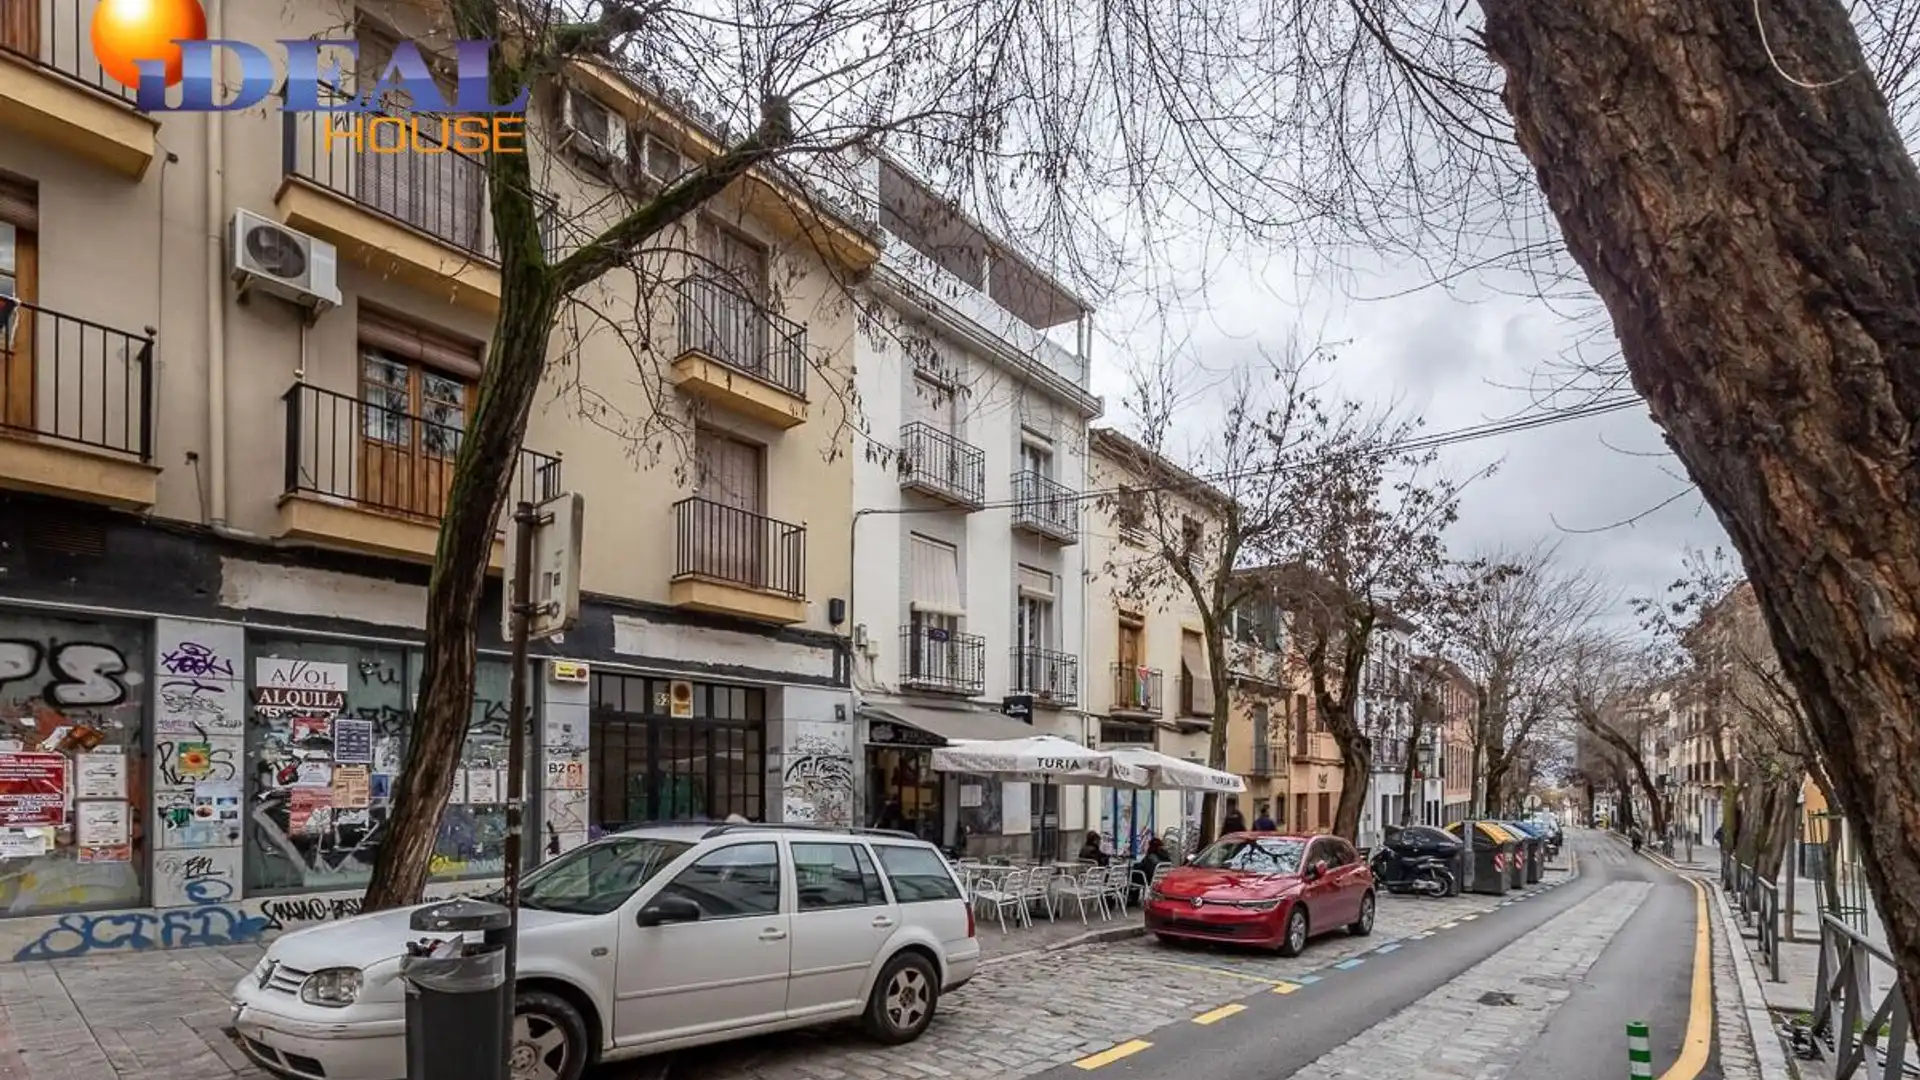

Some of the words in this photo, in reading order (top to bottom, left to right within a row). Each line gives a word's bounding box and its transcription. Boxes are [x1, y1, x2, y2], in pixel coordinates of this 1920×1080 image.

[271, 660, 337, 685] AVOL
[259, 690, 345, 708] ALQUILA
[548, 762, 565, 774] B2
[1037, 757, 1080, 770] TURIA
